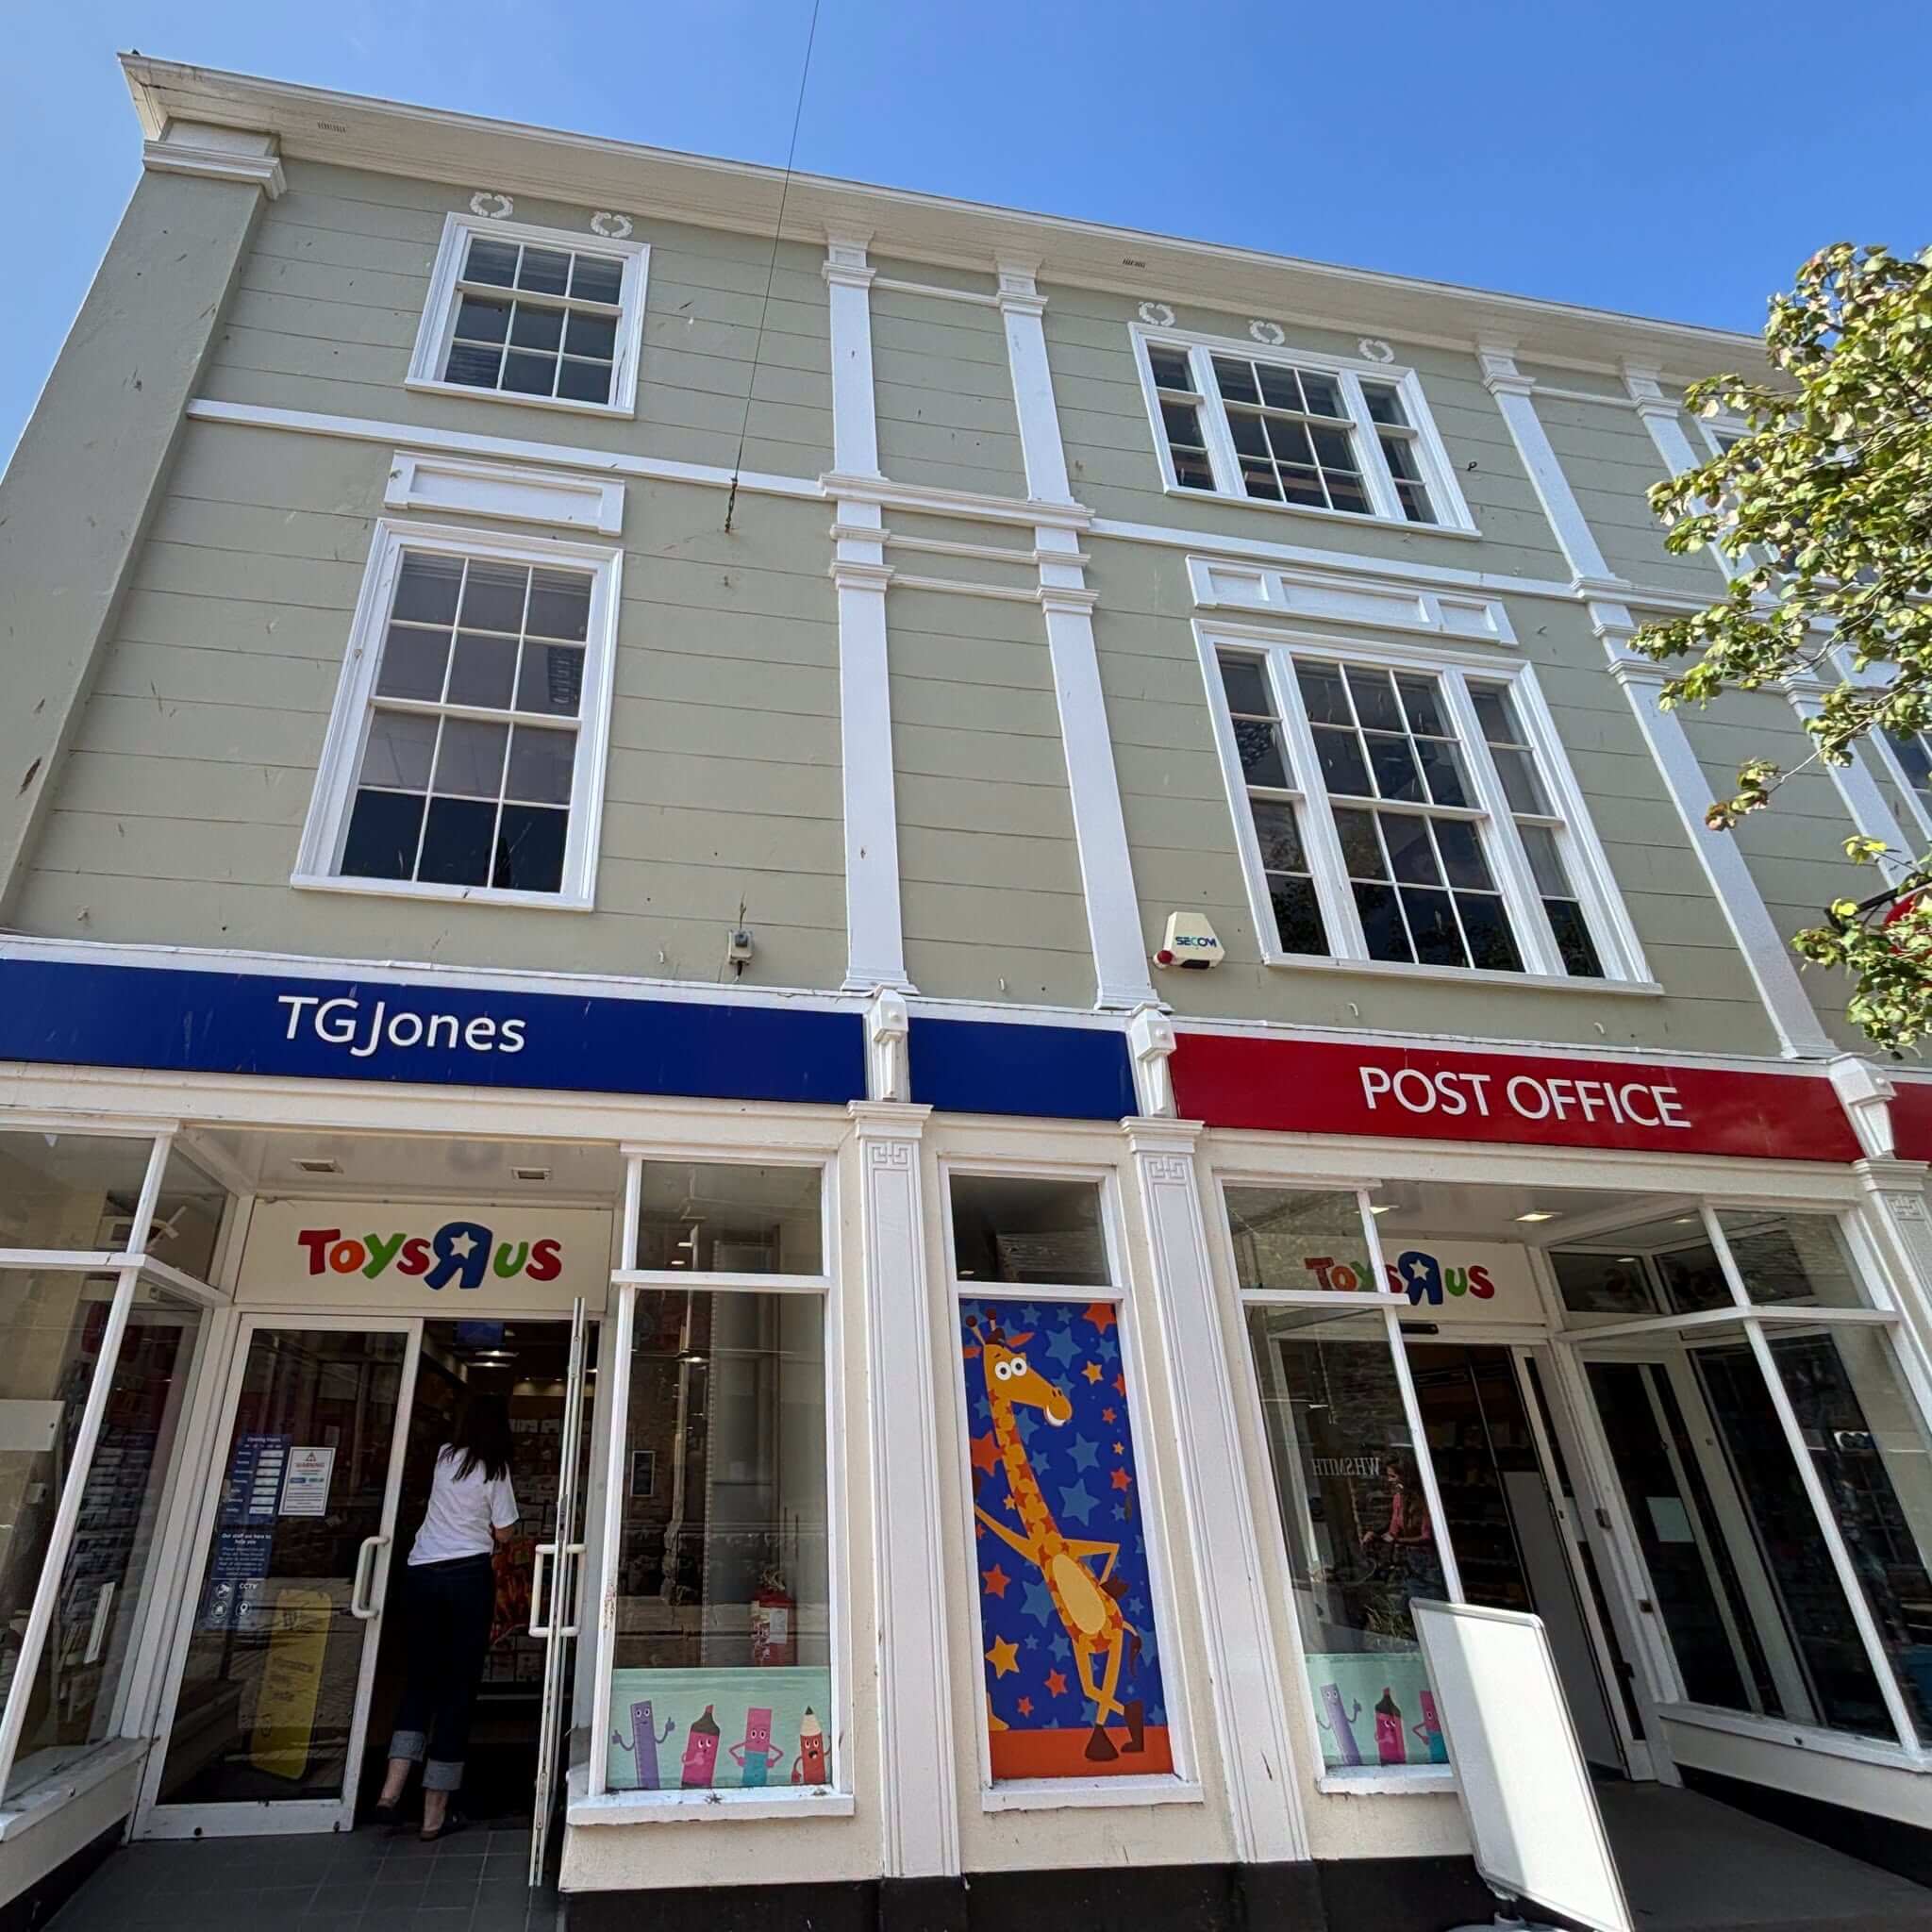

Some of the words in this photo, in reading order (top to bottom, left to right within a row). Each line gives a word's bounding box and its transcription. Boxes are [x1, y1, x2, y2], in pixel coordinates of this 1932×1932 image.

[1175, 936, 1217, 947] SECOM
[1358, 1066, 1491, 1117] POST
[1507, 1075, 1691, 1127] OFFICE
